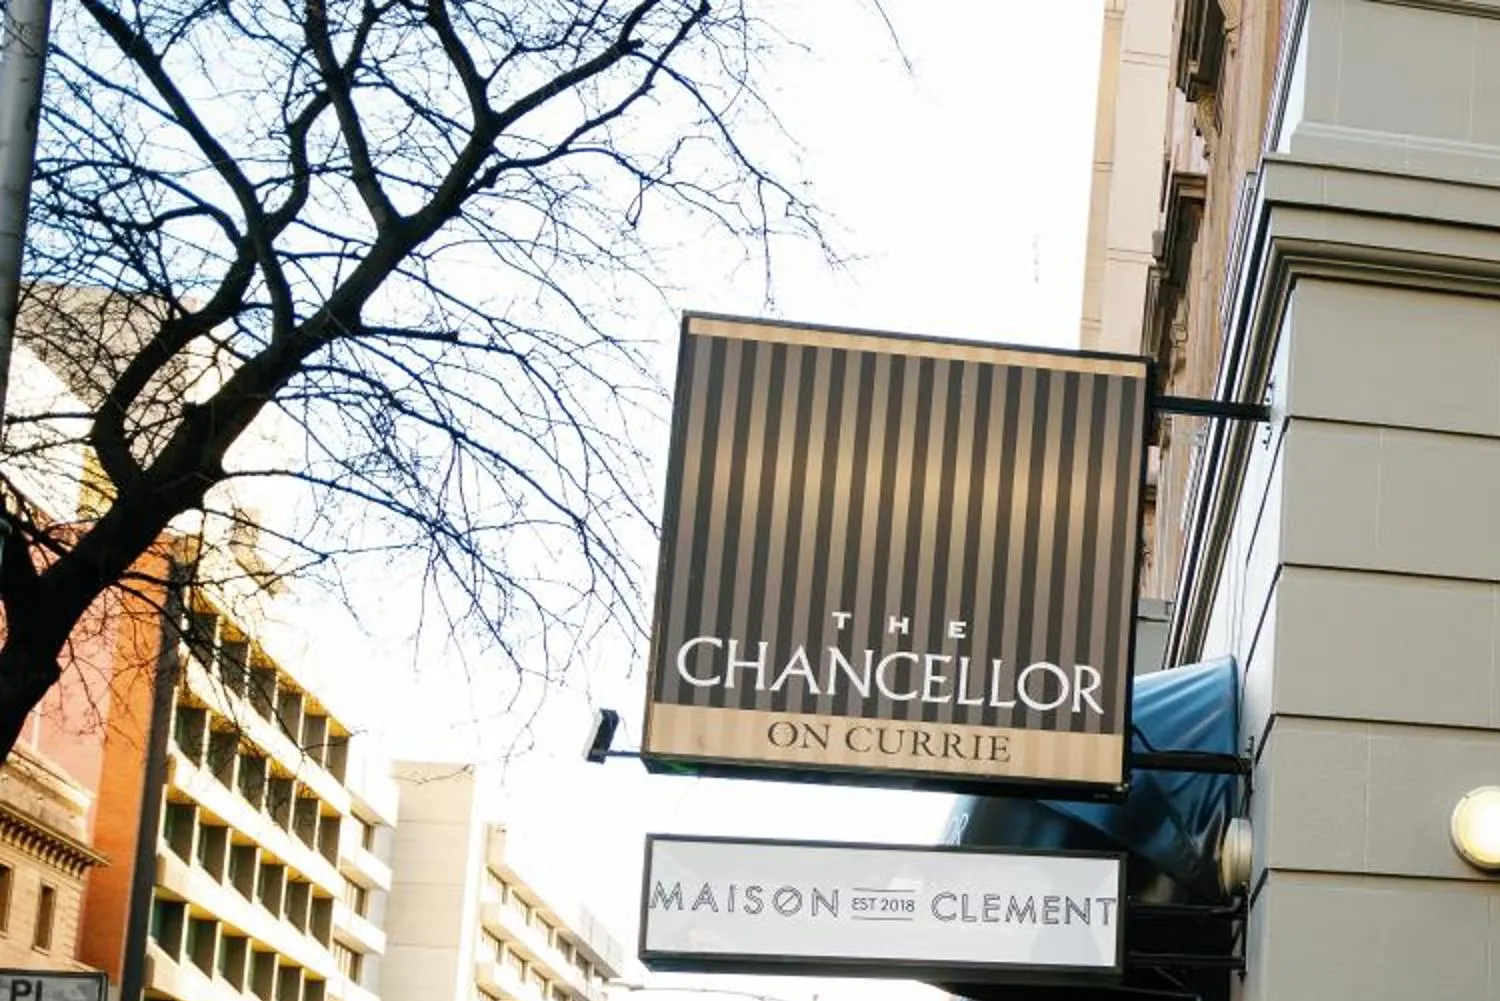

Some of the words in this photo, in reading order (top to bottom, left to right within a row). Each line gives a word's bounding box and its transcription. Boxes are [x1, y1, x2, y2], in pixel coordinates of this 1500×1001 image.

[832, 611, 967, 639] THE
[677, 637, 1105, 715] CHANCELLOR
[768, 721, 831, 751] ON
[845, 726, 1012, 764] CURRIE
[851, 897, 876, 912] EST
[880, 898, 916, 913] 2018
[931, 892, 1118, 926] CLEMENT
